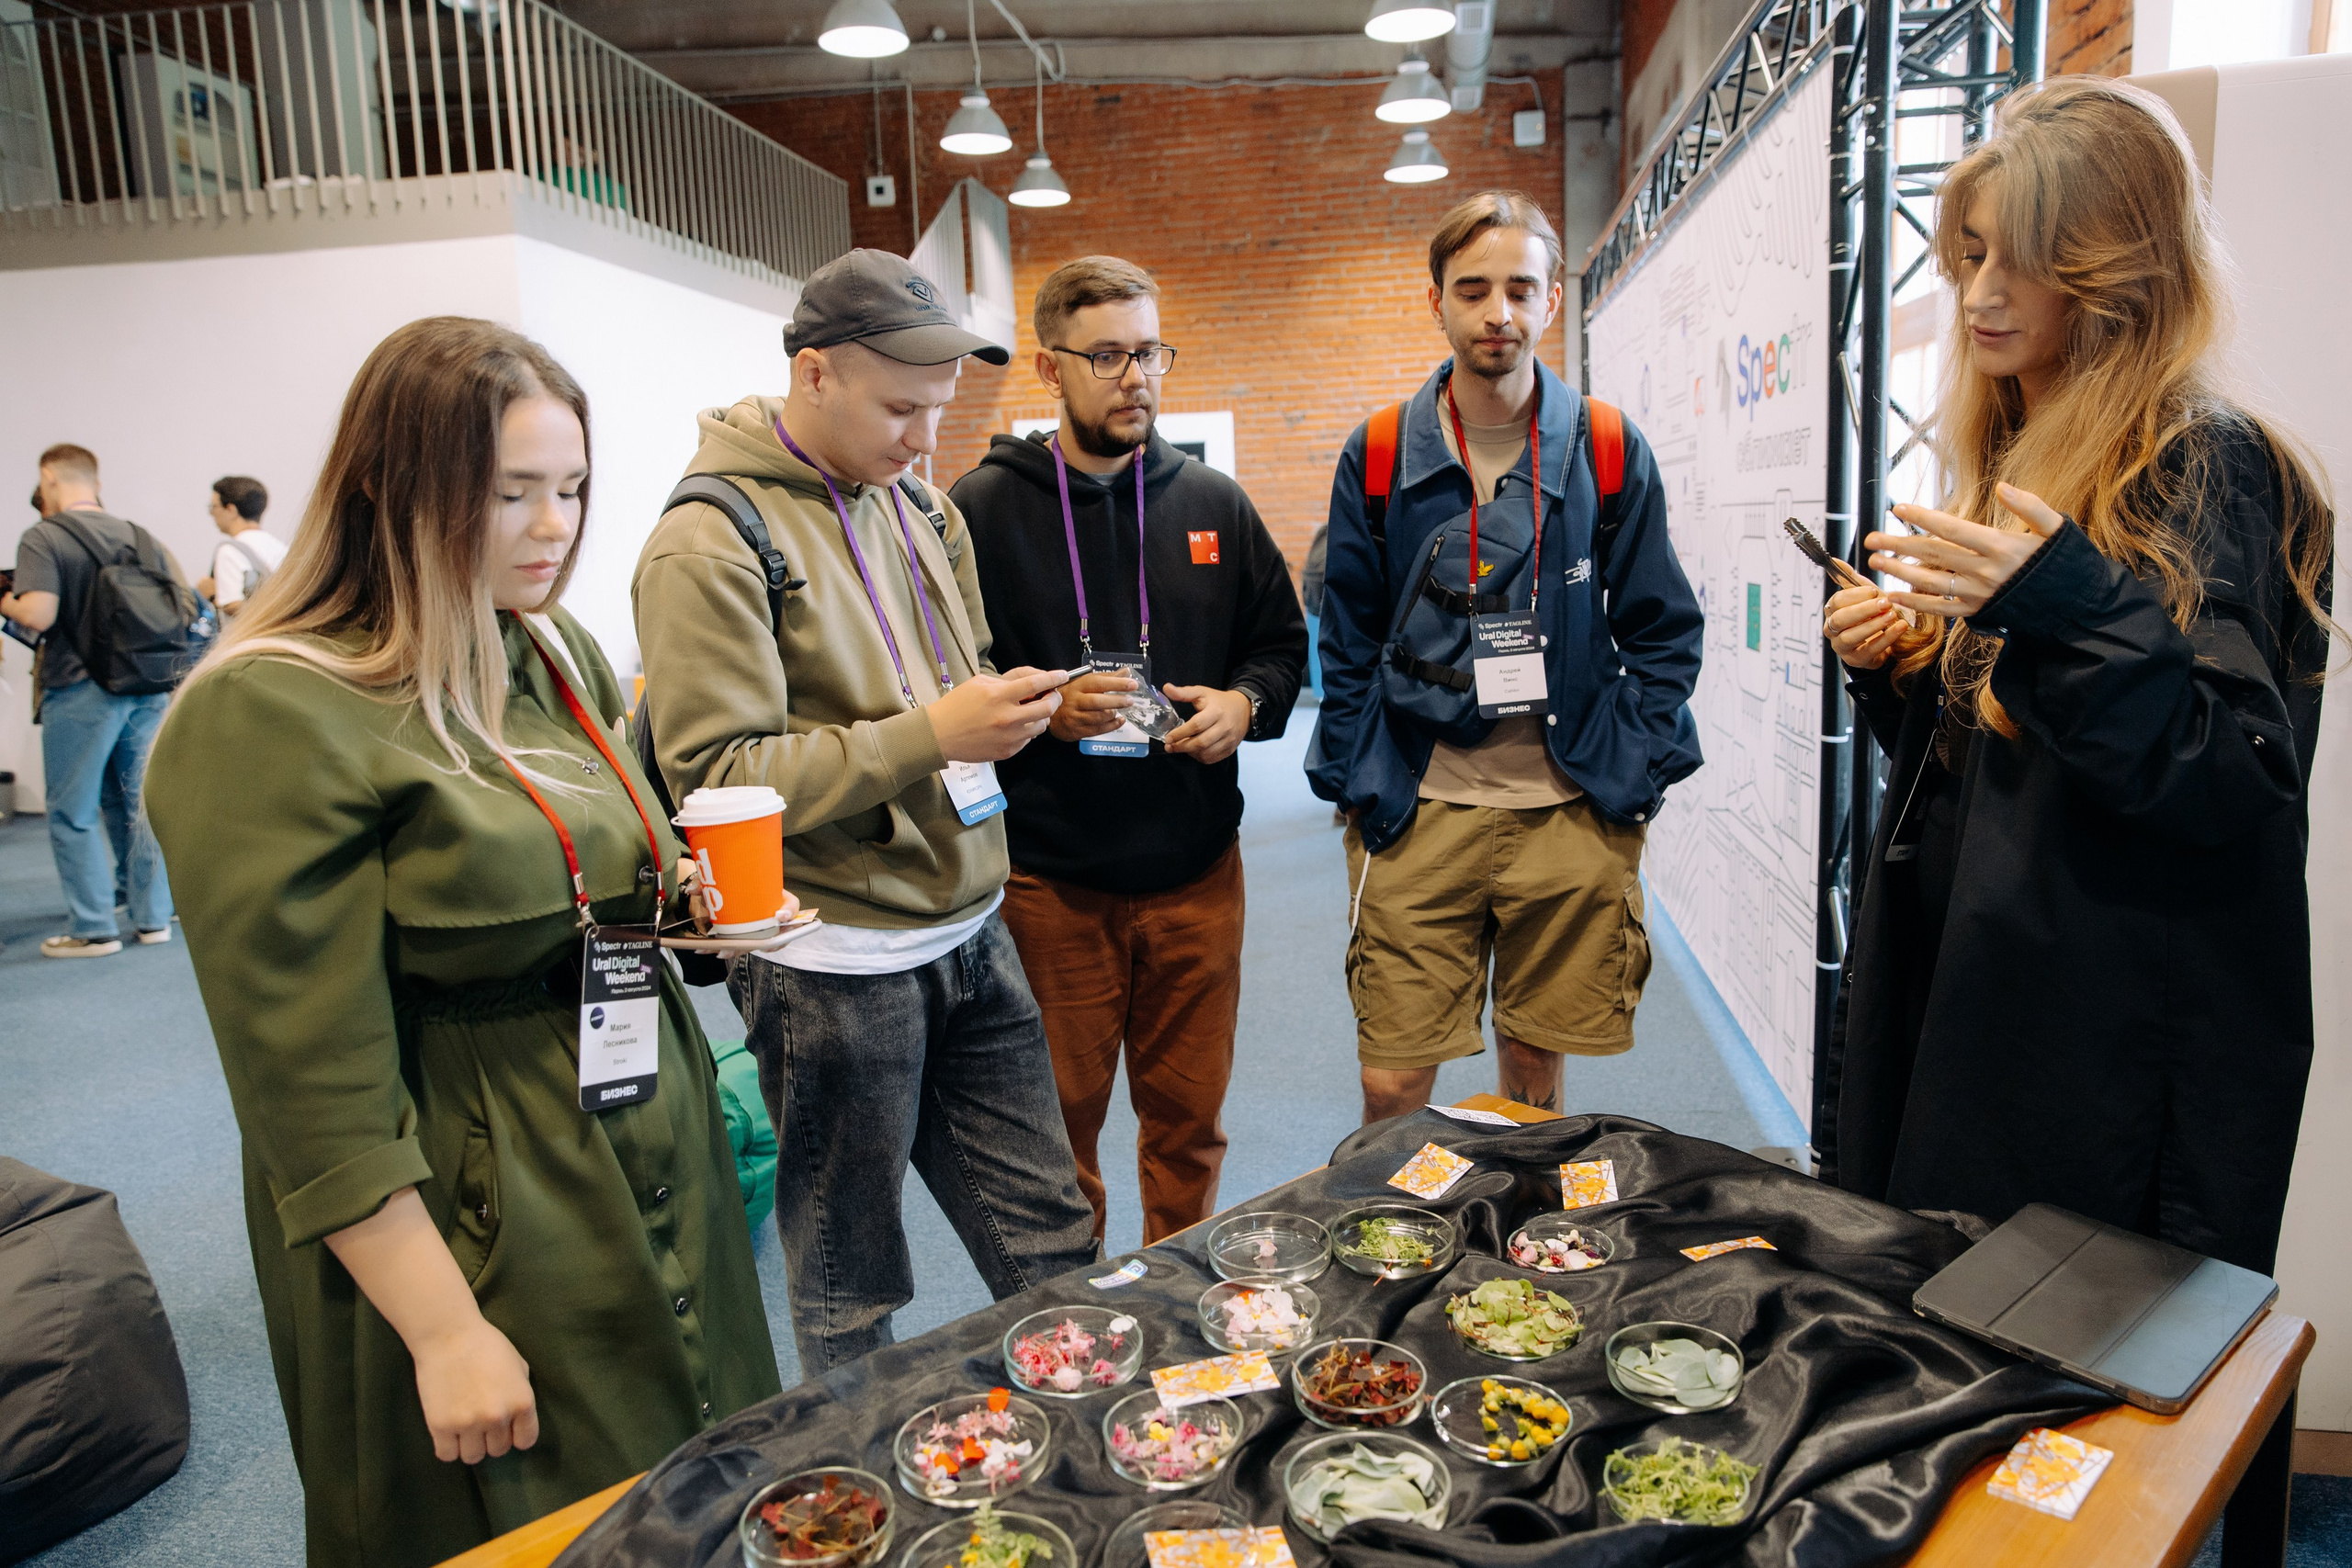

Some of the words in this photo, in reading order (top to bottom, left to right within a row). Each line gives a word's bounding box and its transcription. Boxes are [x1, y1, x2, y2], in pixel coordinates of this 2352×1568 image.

[1737, 312, 1813, 423] Spectr
[1478, 631, 1496, 641] Ural
[1496, 628, 1522, 640] Digital
[1491, 638, 1529, 649] Weekend
[1498, 705, 1531, 715] БИЗНЕС
[1091, 744, 1136, 753] СТАНДАРТ
[969, 800, 999, 818] СТАНДАРТ
[601, 942, 622, 953] Spectr
[628, 941, 653, 950] TAGLINE
[592, 957, 612, 972] Ural
[612, 954, 640, 973] Digital
[605, 971, 646, 986] Weekend
[609, 1022, 631, 1033] Мария
[602, 1037, 638, 1049] Лесникова
[600, 1084, 639, 1101] БИЗНЕС
